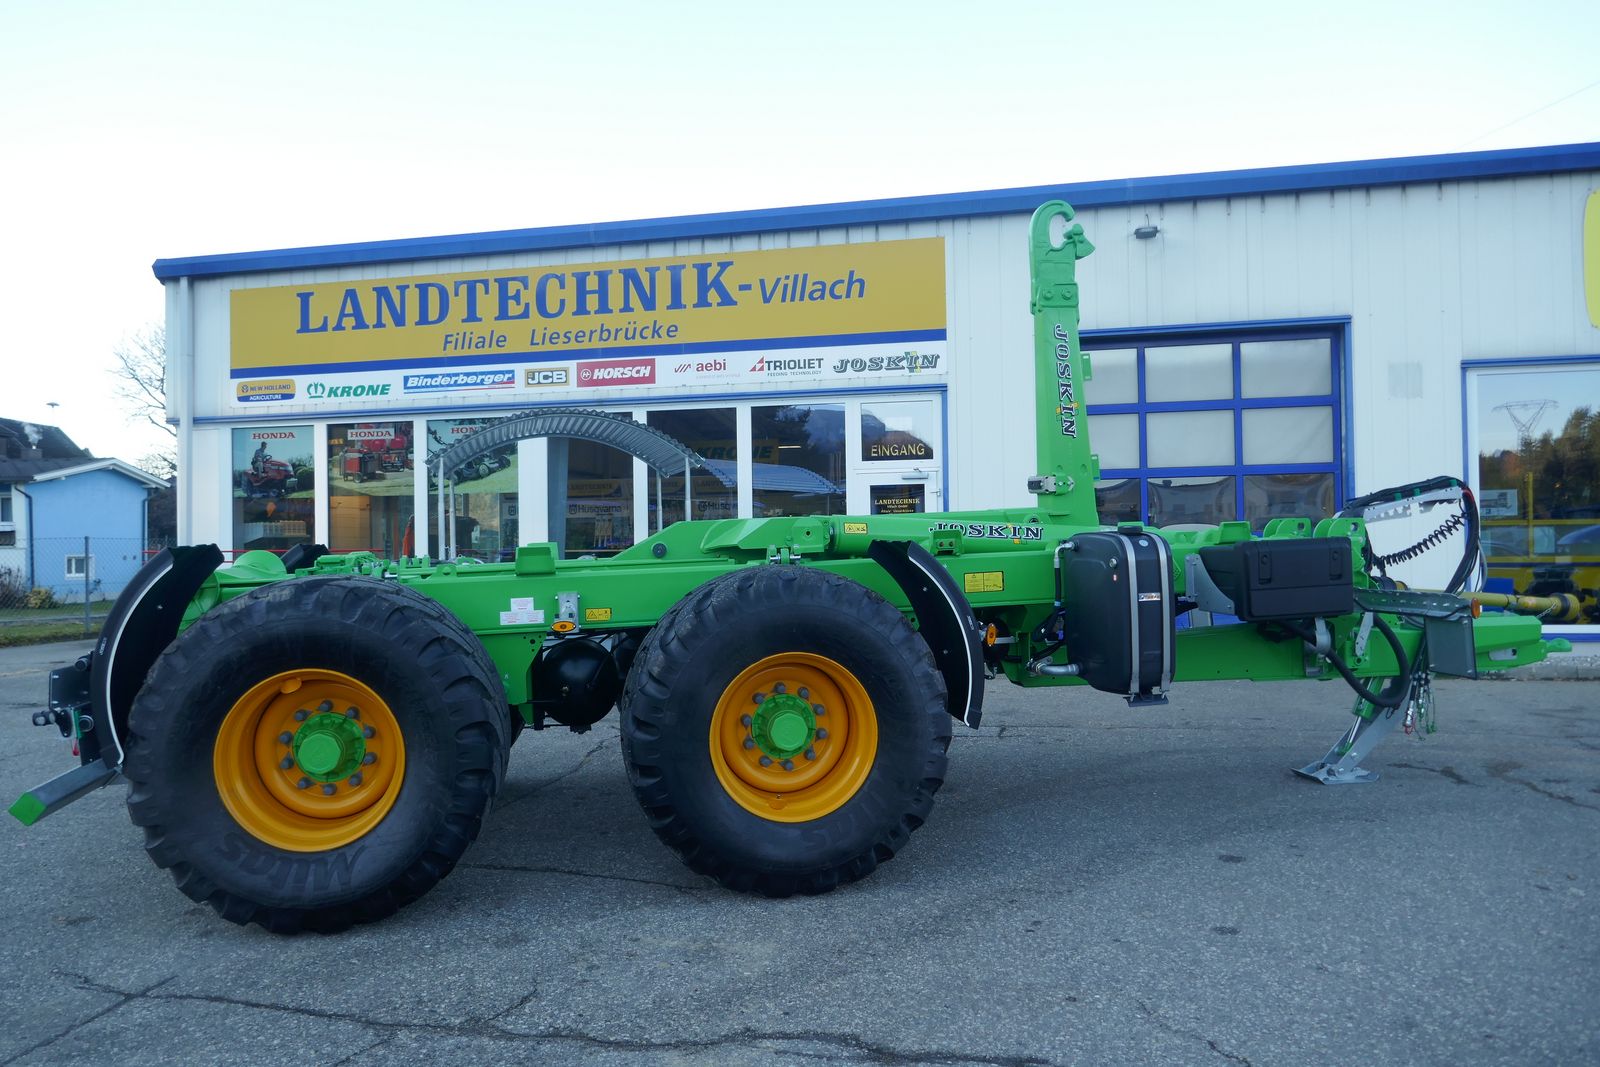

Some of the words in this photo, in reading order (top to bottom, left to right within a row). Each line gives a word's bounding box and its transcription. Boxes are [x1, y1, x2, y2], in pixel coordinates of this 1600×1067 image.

[442, 330, 507, 351] Filiale
[529, 320, 679, 346] Lieserbrücke
[696, 359, 727, 372] aebi
[765, 358, 824, 371] TRIOLIET
[832, 352, 940, 374] JOSKIN
[407, 373, 512, 387] Binderberger
[527, 370, 567, 384] JCB
[593, 366, 651, 380] HORSCH
[1054, 323, 1078, 439] JOSKIN
[327, 384, 391, 398] KRONE
[252, 431, 296, 440] HONDA
[350, 430, 392, 438] HONDA
[871, 443, 925, 457] EINGANG
[577, 504, 622, 514] Husqvarna
